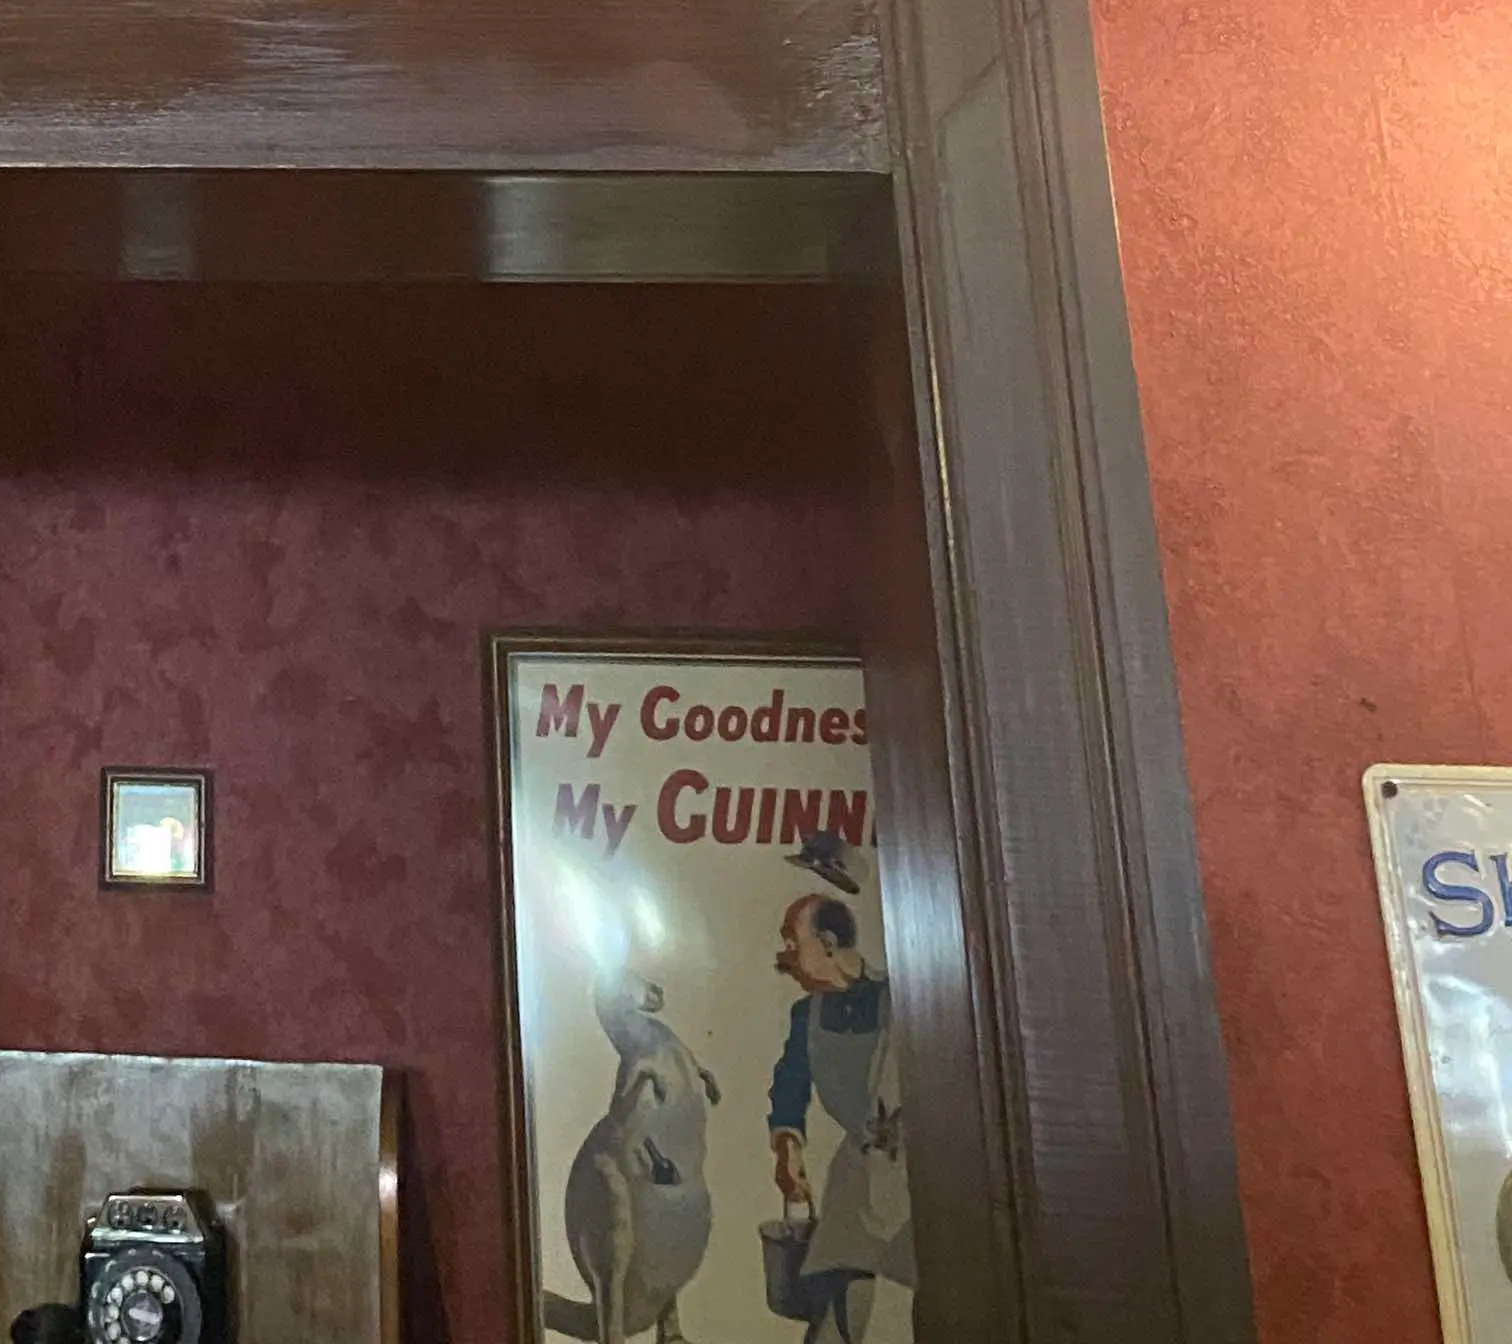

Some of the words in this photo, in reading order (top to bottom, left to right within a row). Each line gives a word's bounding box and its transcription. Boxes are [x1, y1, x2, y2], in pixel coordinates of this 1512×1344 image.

[536, 683, 622, 758] My
[552, 783, 637, 856] My
[656, 768, 878, 847] GUINN
